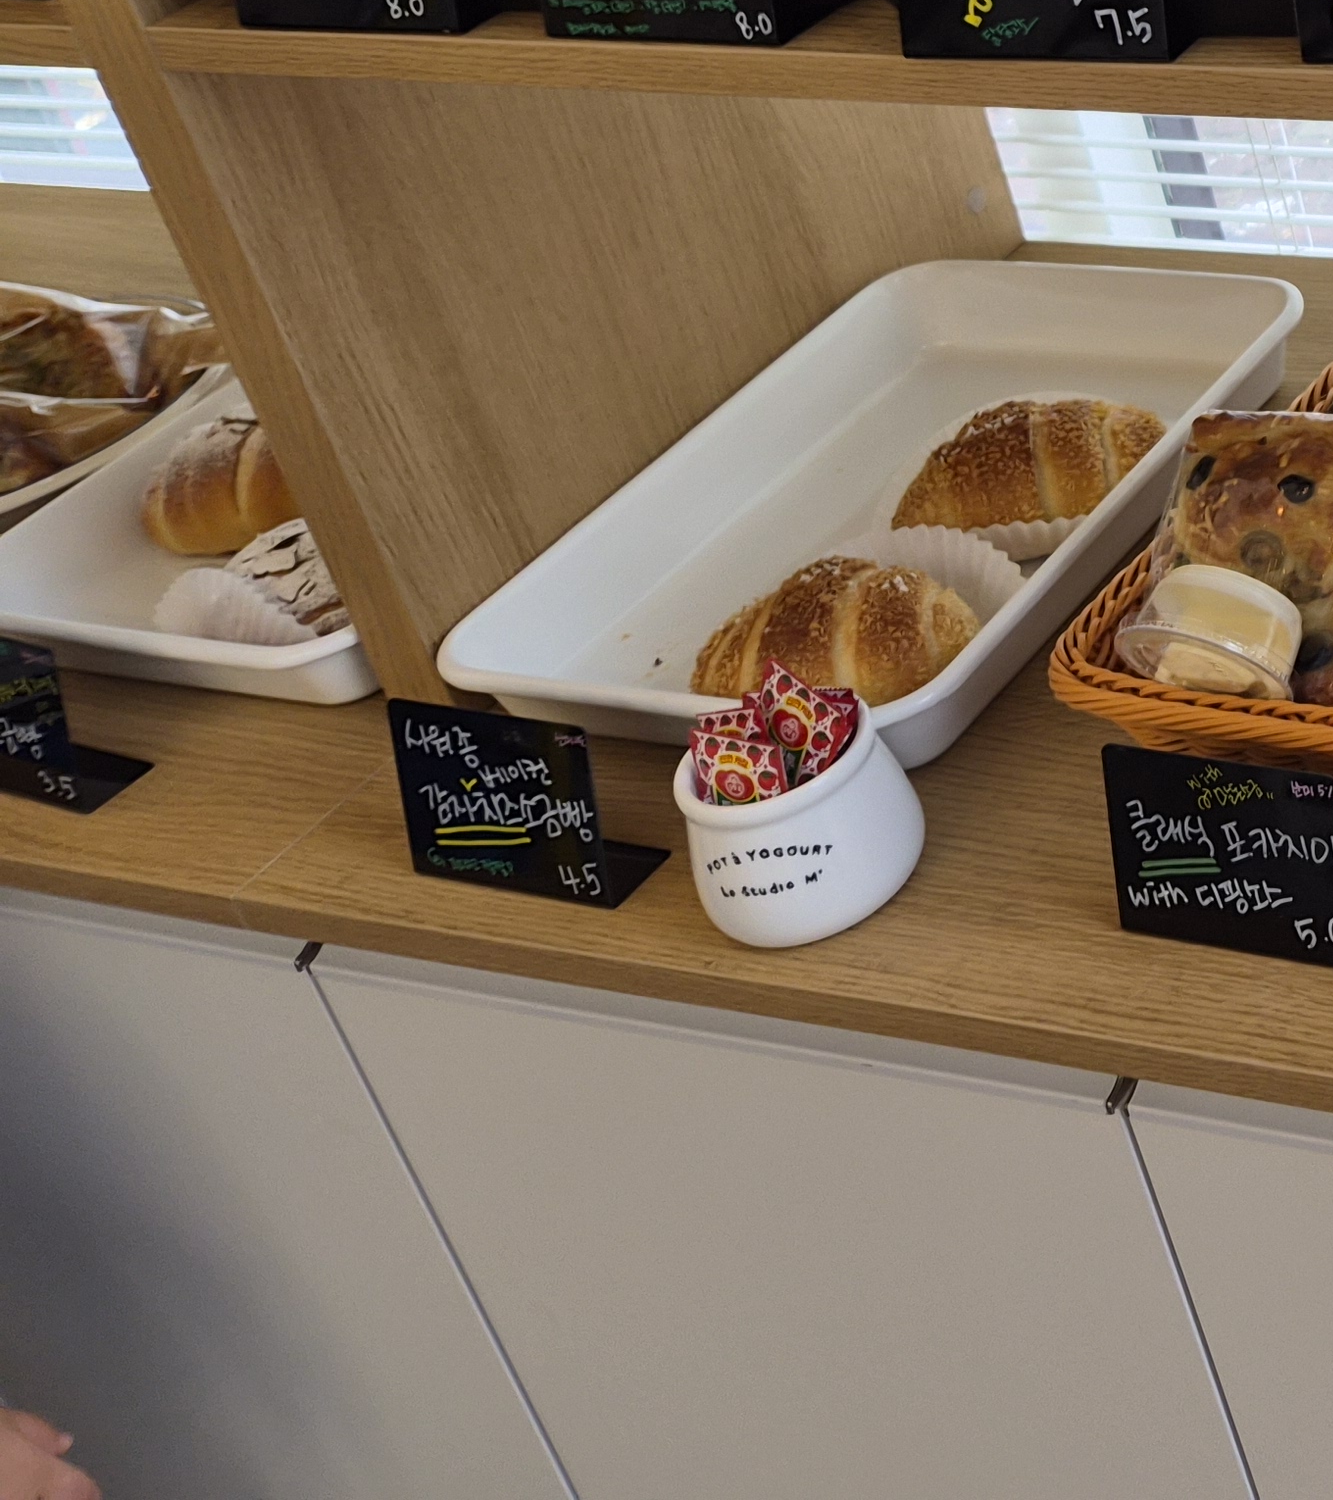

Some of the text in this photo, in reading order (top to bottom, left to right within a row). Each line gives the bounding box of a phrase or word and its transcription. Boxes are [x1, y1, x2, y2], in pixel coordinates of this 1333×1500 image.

[735, 11, 773, 40] 8.0
[1093, 7, 1153, 46] 7.5
[746, 844, 834, 862] YOGOURT
[558, 862, 602, 896] 4.5
